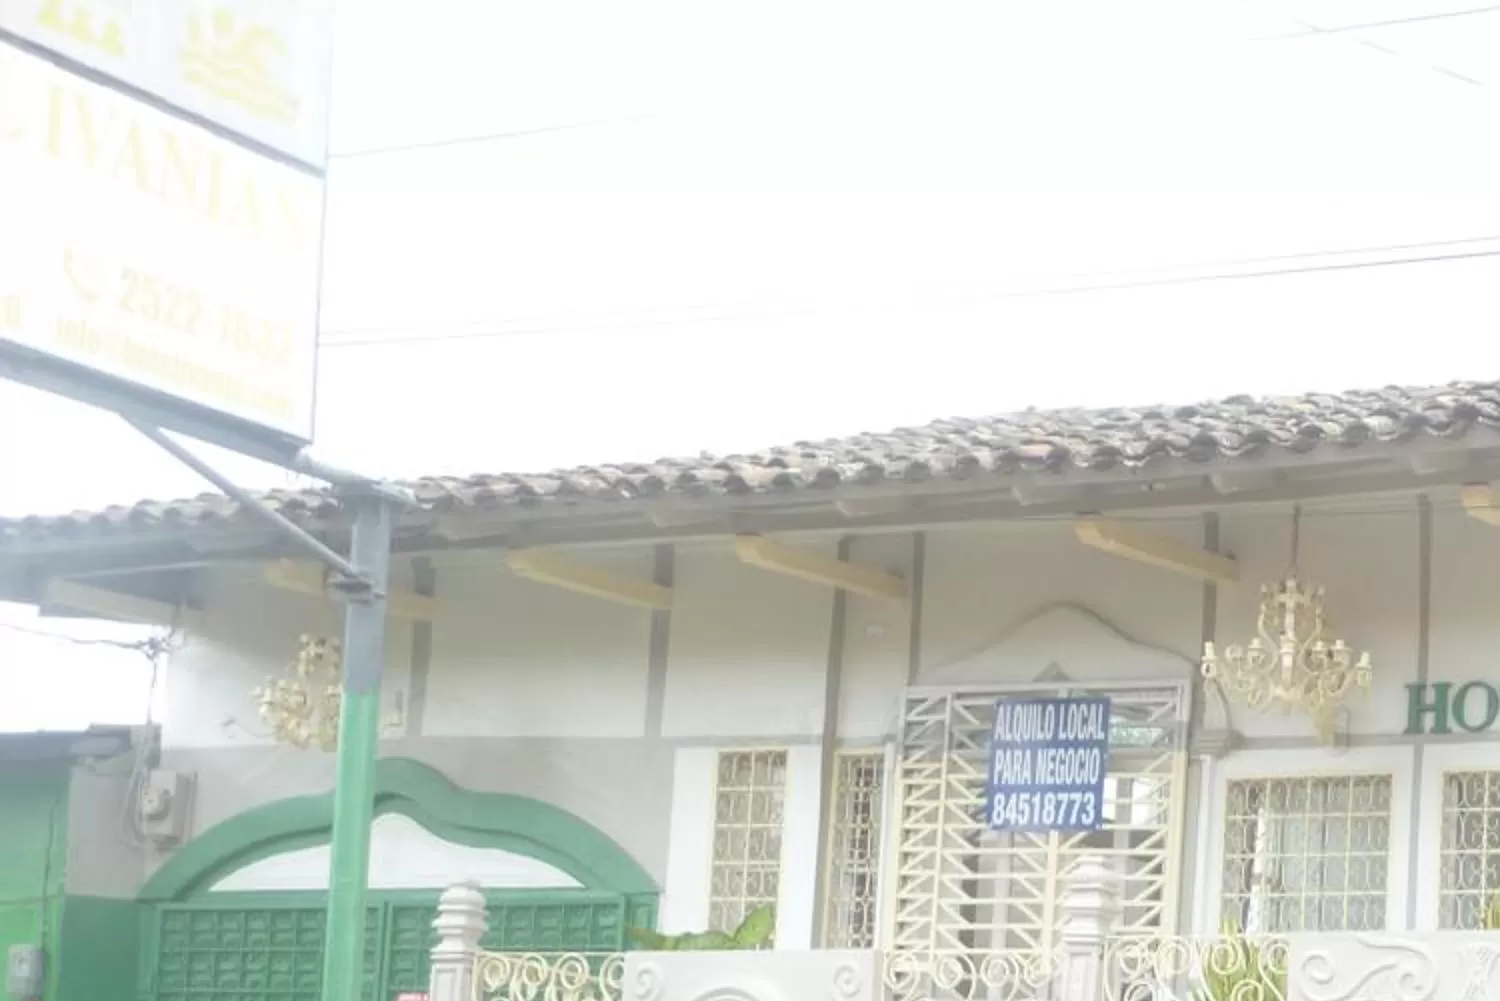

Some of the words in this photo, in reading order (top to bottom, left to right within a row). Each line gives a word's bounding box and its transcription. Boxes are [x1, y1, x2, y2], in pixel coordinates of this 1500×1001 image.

[995, 703, 1054, 741] ALQUILO
[1058, 703, 1105, 740] LOCAL
[993, 749, 1031, 785] PARA
[1035, 748, 1100, 785] NEGOCIO
[991, 792, 1095, 825] 84518773
